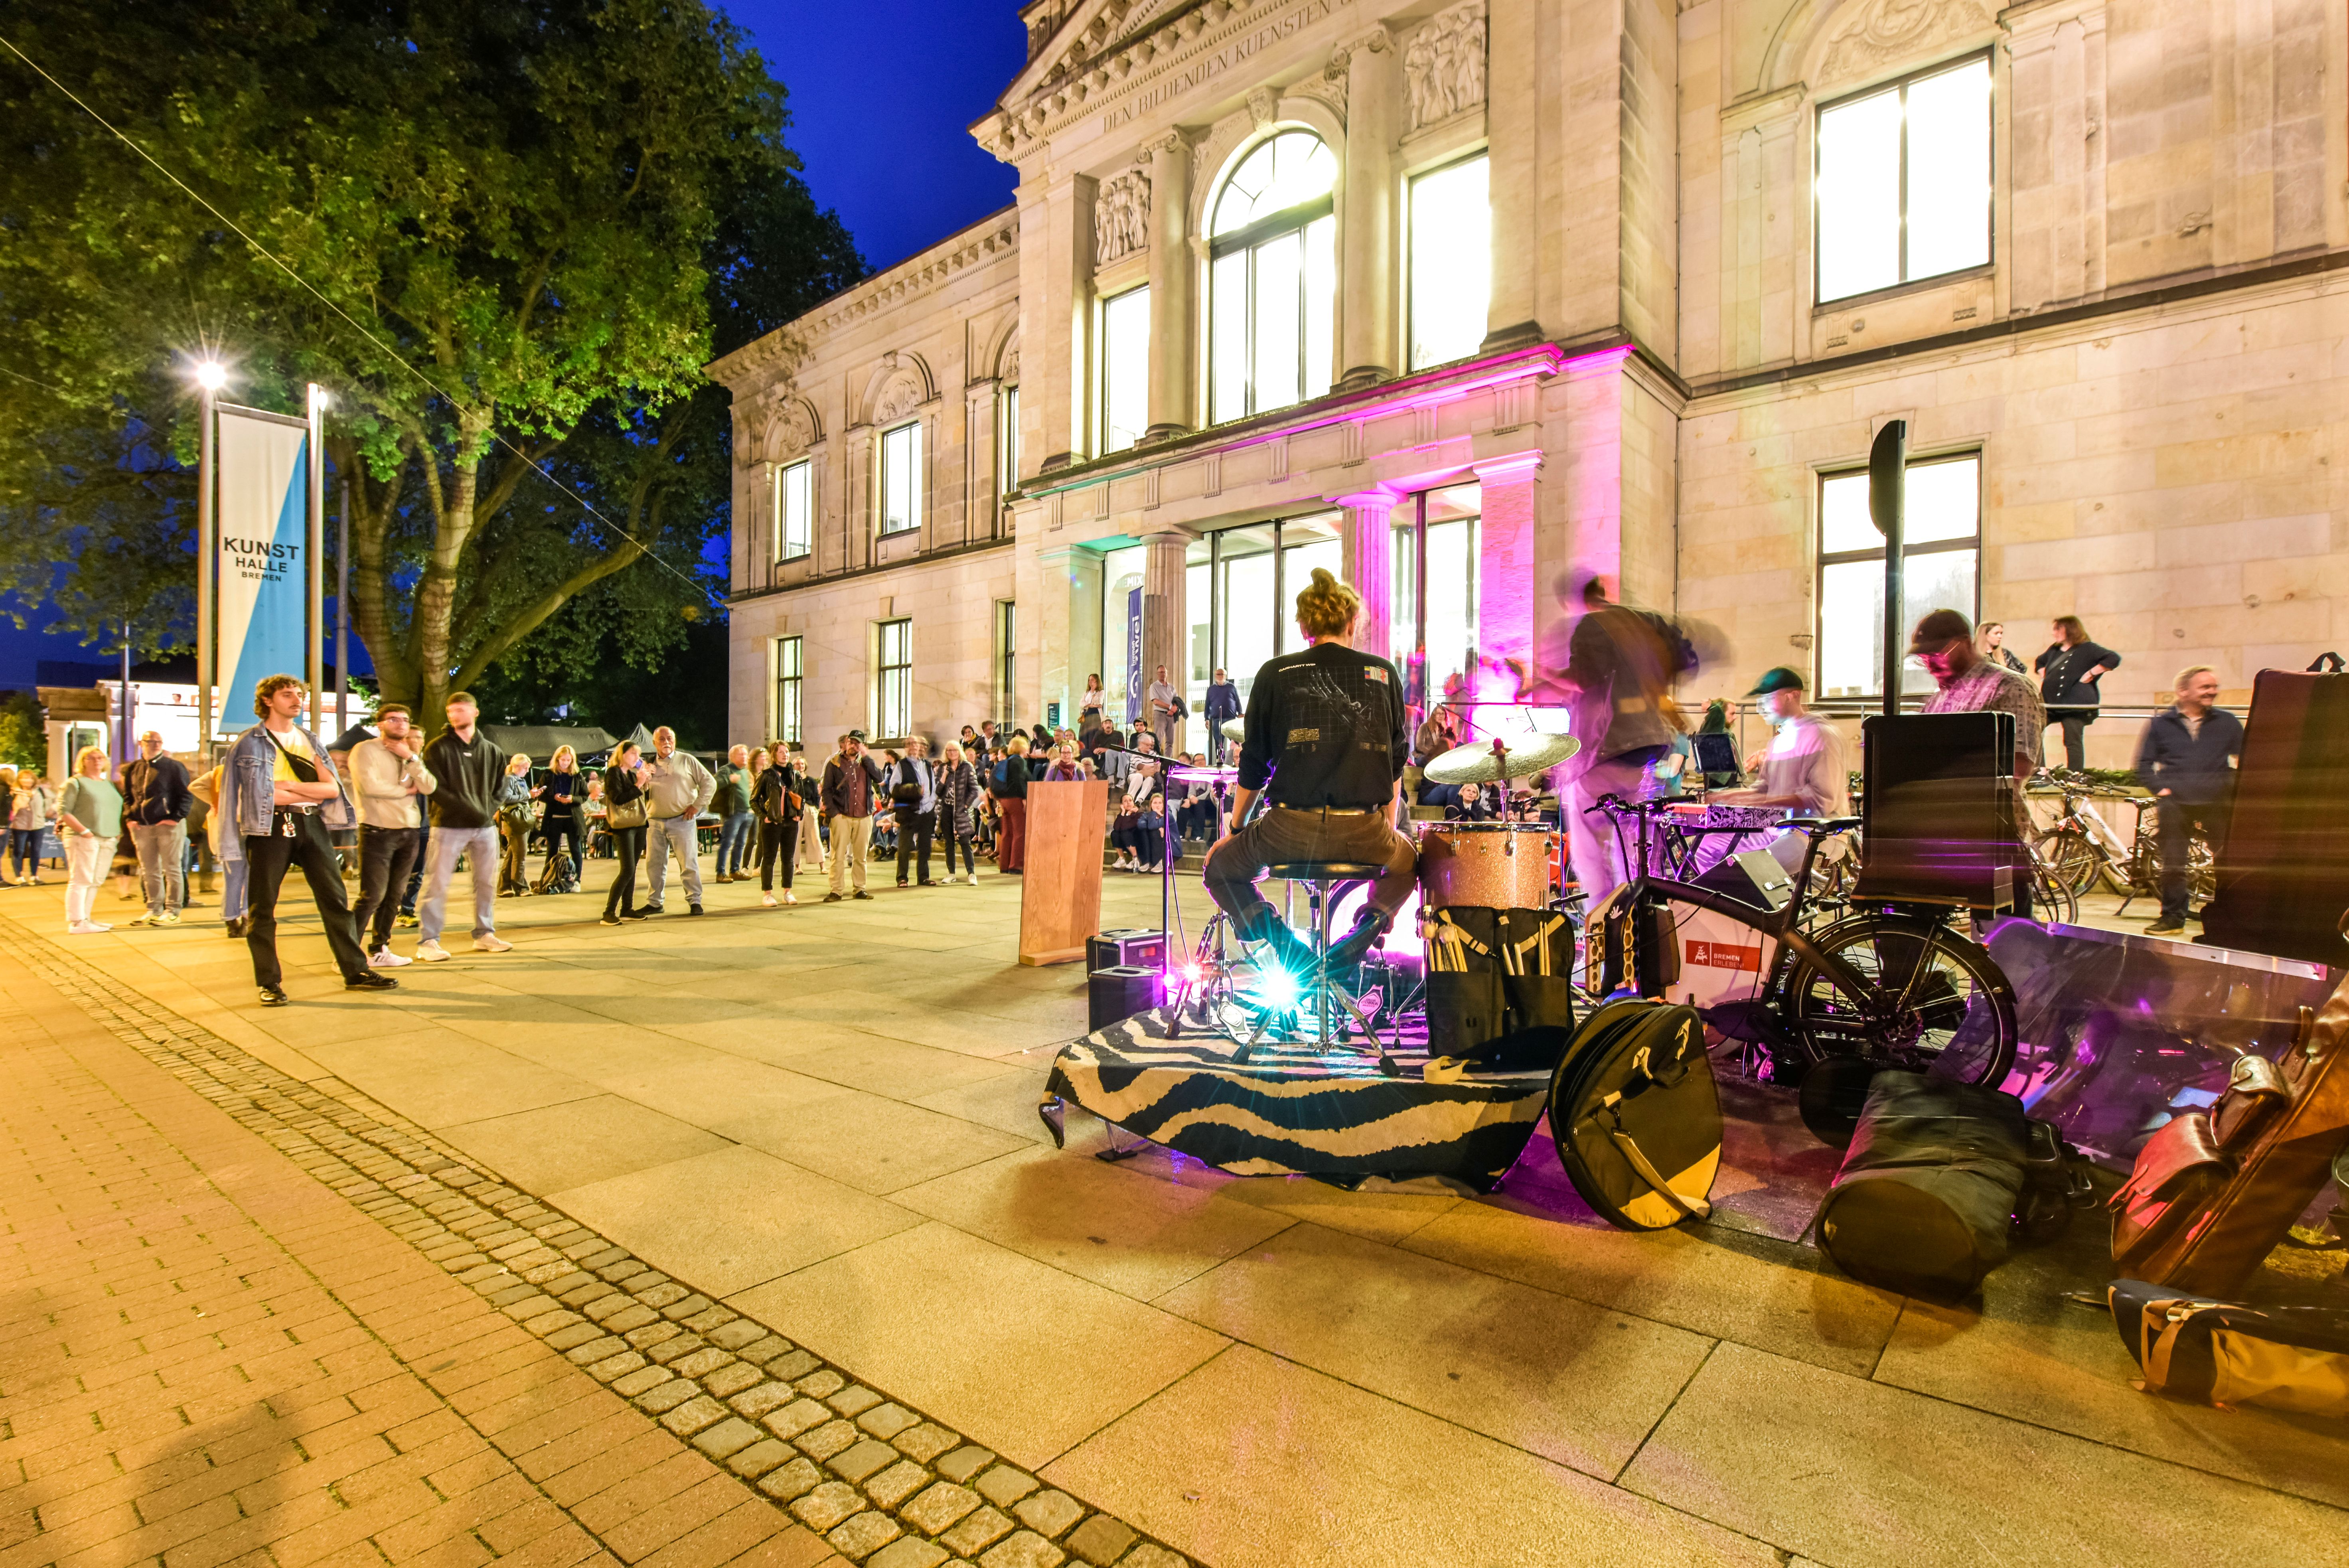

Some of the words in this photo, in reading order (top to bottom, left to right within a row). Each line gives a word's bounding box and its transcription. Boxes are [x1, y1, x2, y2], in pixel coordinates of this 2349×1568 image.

[1104, 104, 1131, 132] DEN
[1139, 50, 1228, 114] BILDENDEN
[1236, 0, 1330, 63] KUENSTEN
[224, 537, 299, 559] KUNST
[236, 557, 287, 573] HALLE
[241, 571, 282, 582] BREMEN
[1278, 664, 1305, 672] CARHARTT
